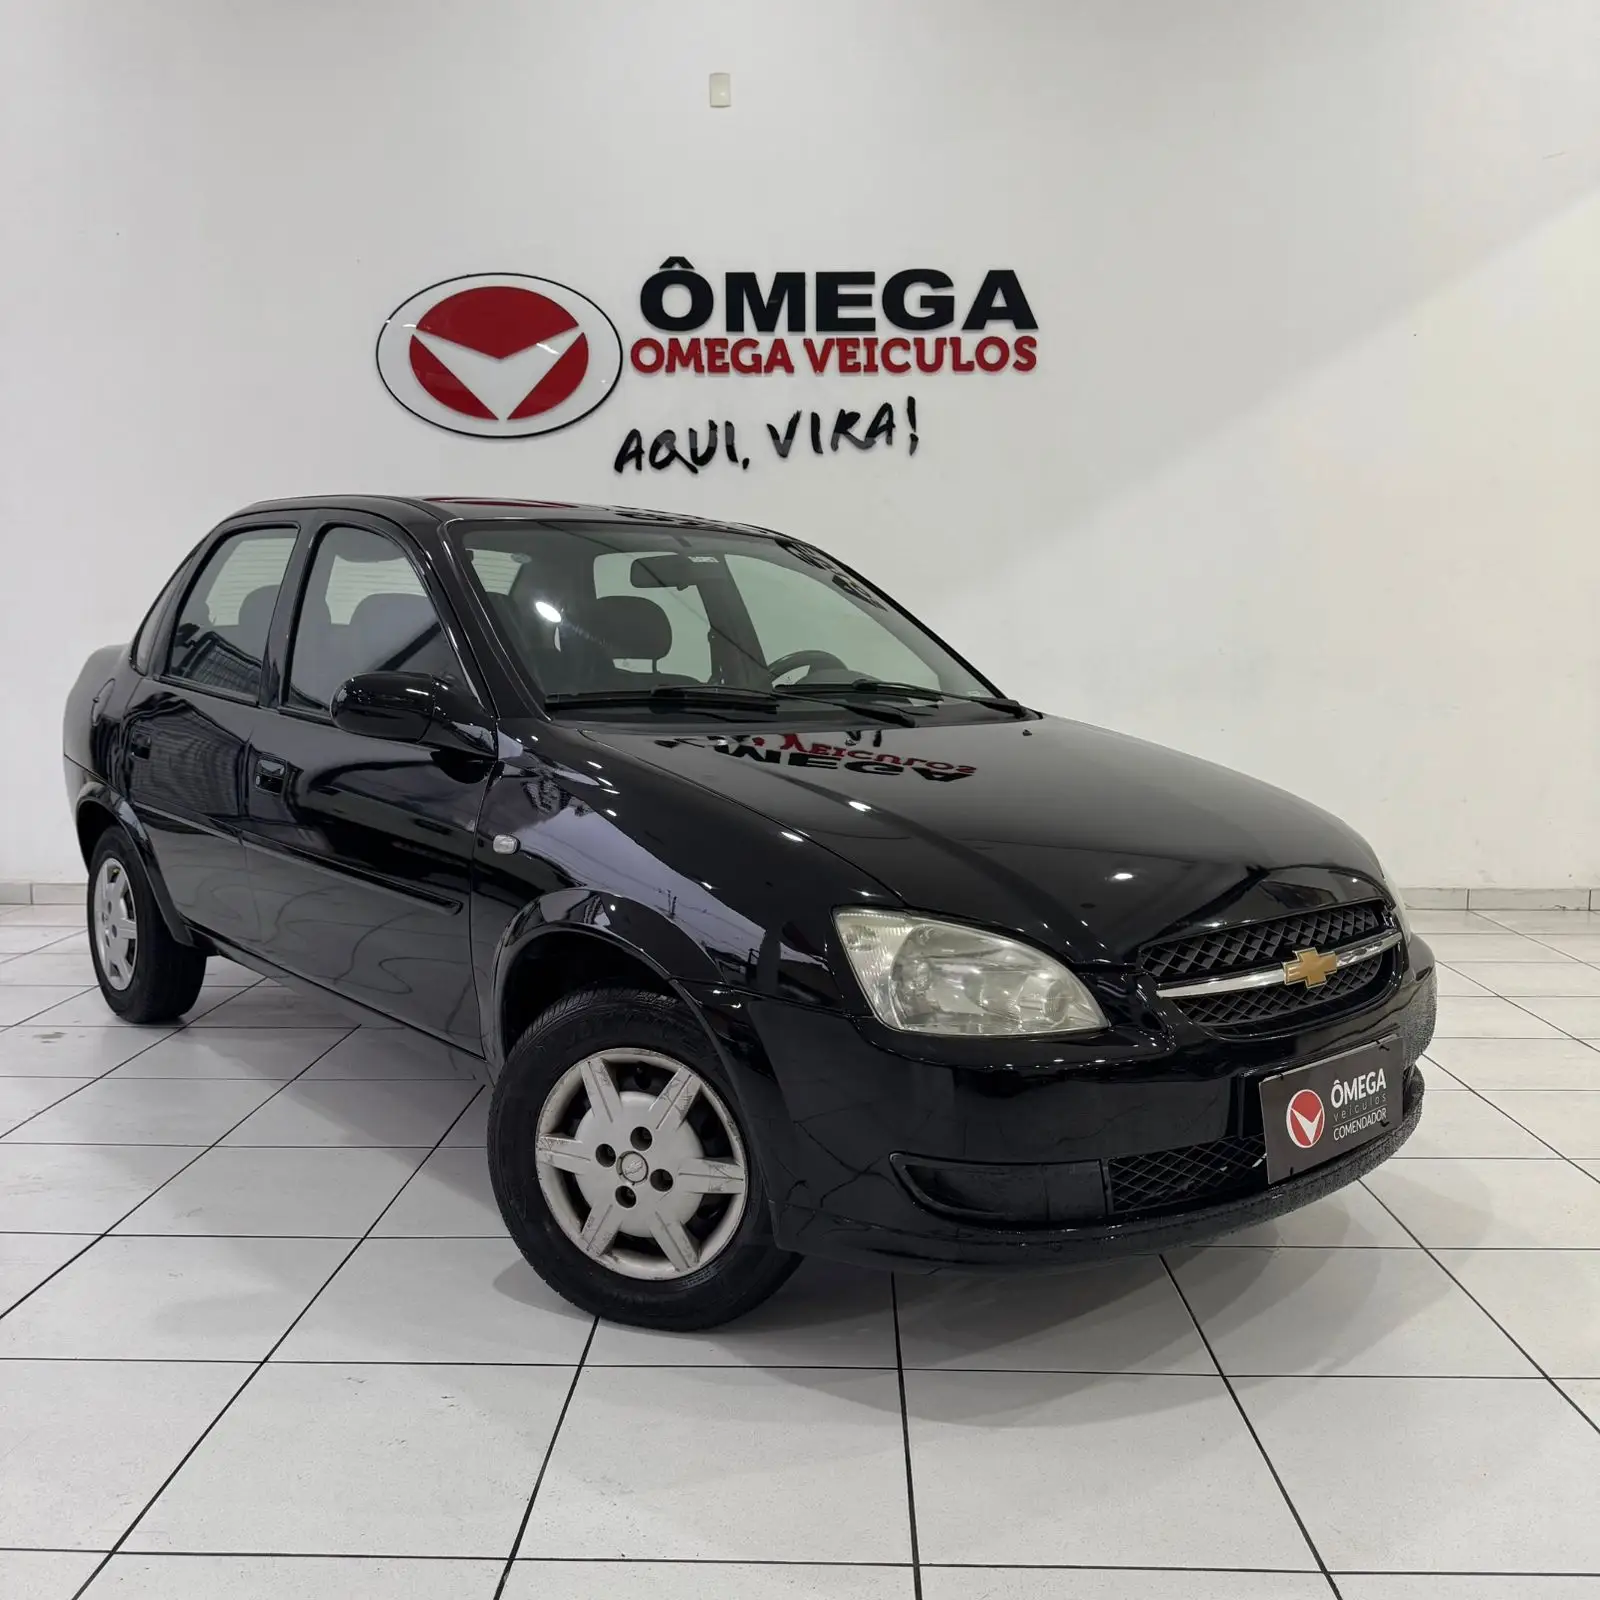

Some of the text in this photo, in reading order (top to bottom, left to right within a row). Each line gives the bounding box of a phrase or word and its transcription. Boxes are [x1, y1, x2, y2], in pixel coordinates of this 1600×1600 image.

[640, 256, 1039, 333] ÔMEGA
[630, 335, 1037, 374] OMEGA VEICULOS
[613, 395, 920, 475] AQUI, VIRA!
[1330, 1067, 1387, 1109] ÔMEGA
[1333, 1107, 1387, 1141] COMENDADOR
